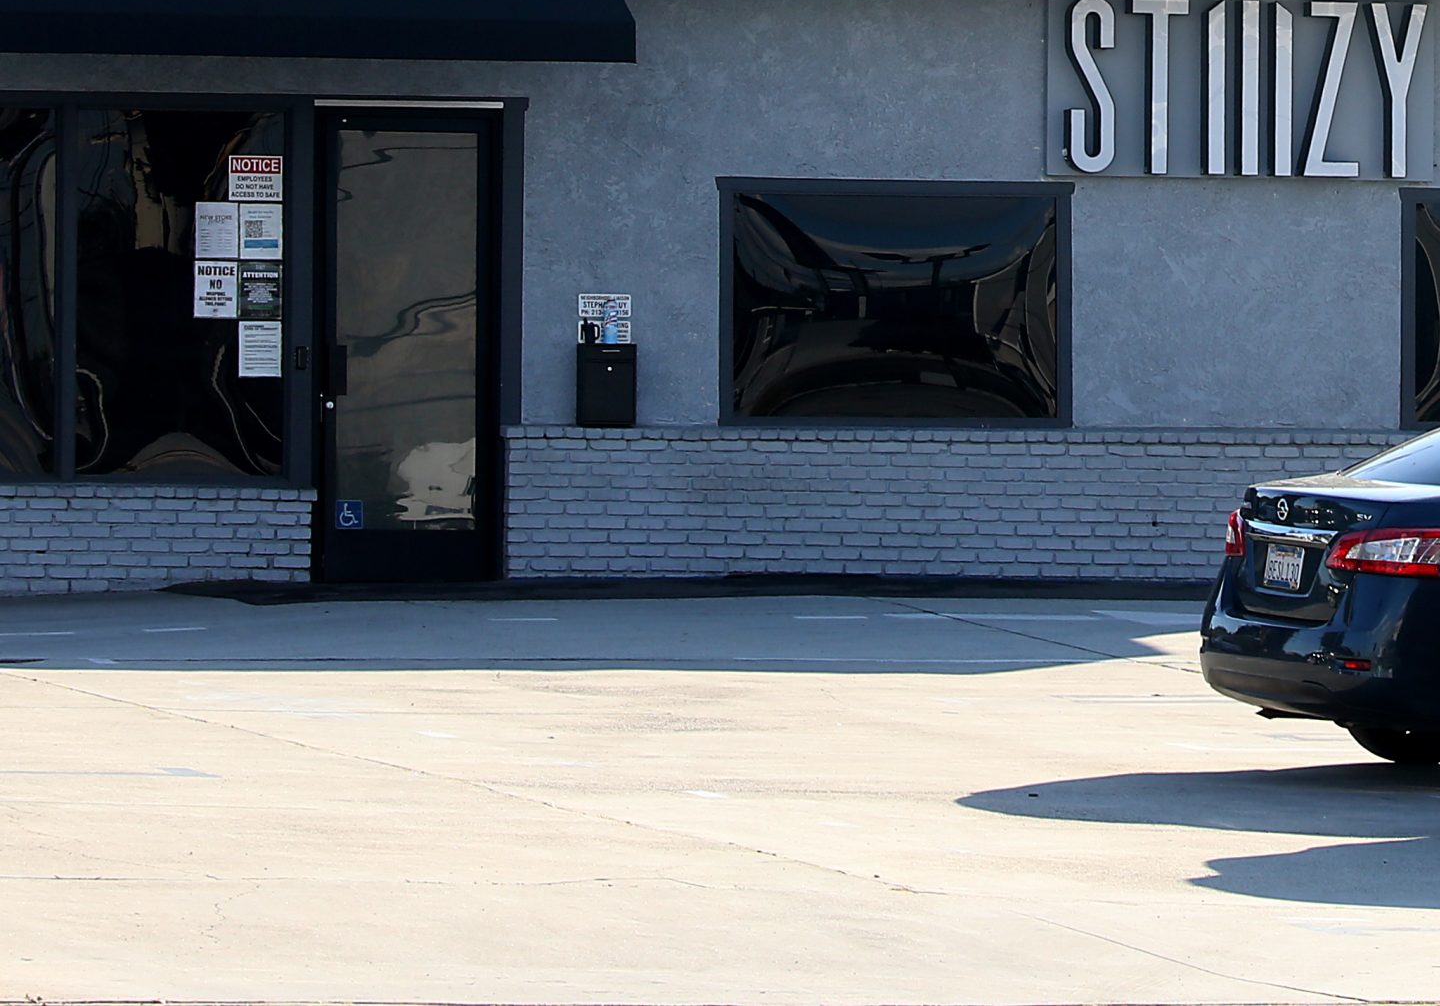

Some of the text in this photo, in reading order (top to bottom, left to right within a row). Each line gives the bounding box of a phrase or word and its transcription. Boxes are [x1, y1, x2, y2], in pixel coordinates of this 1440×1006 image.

[232, 159, 279, 172] NOTICE
[198, 266, 235, 276] NOTICE
[209, 279, 222, 289] NO
[1356, 513, 1373, 522] SV
[1267, 560, 1300, 582] 8ESL130
